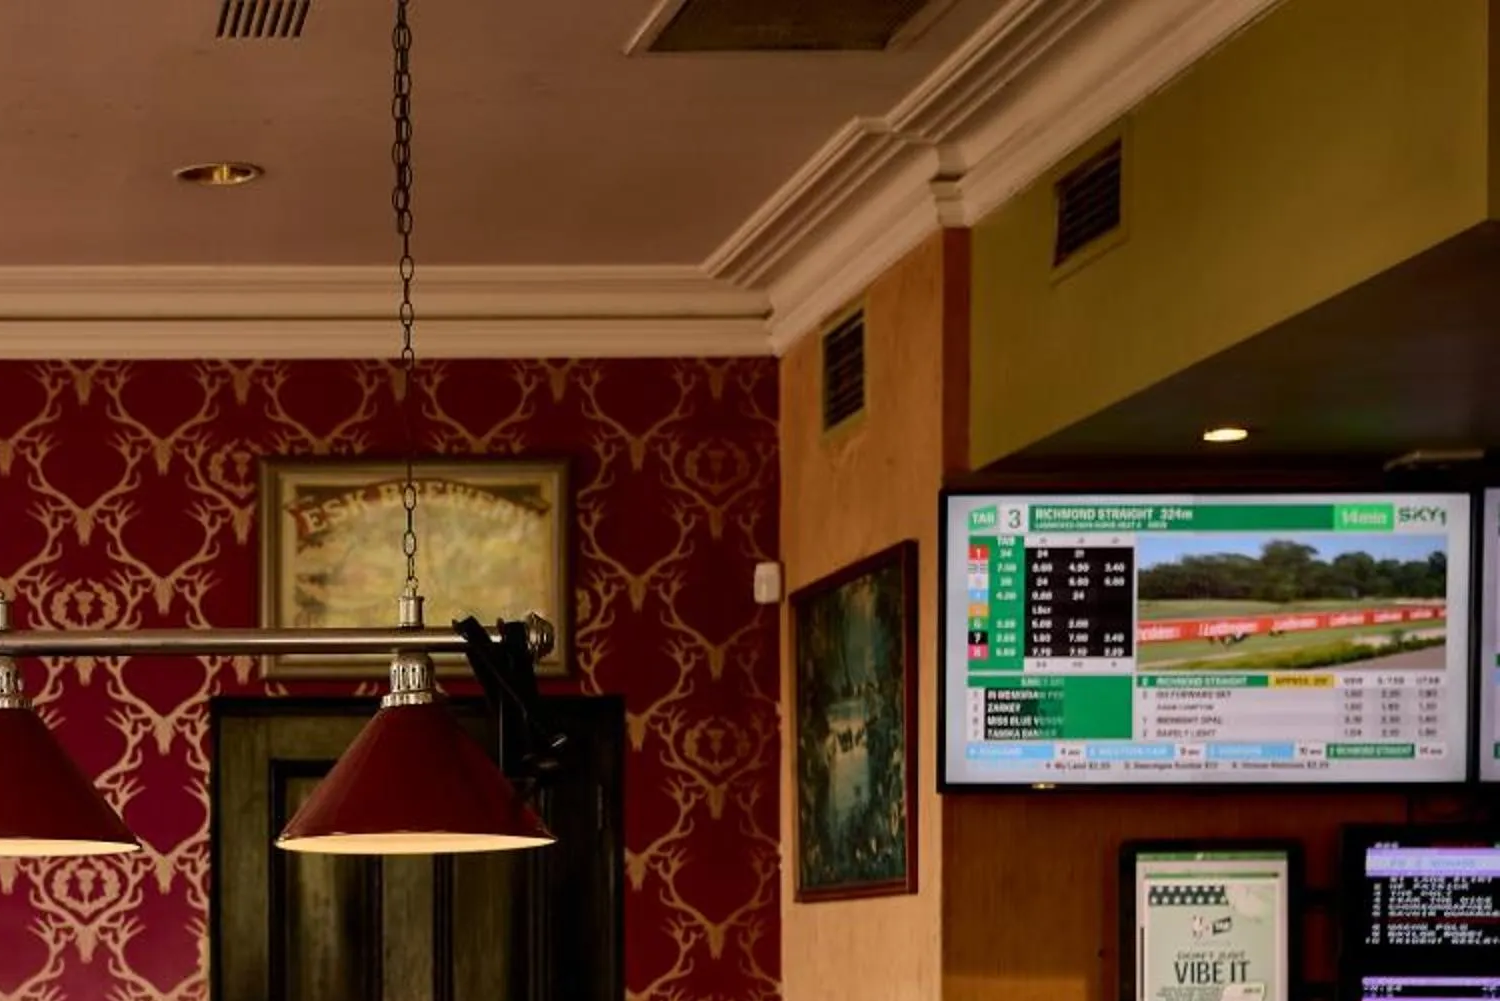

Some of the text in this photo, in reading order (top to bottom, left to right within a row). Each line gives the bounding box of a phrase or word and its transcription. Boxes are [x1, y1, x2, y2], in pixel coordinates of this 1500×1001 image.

[1008, 509, 1021, 529] 3
[1035, 508, 1096, 521] RICHMOND
[1174, 960, 1251, 984] VIBE IT
